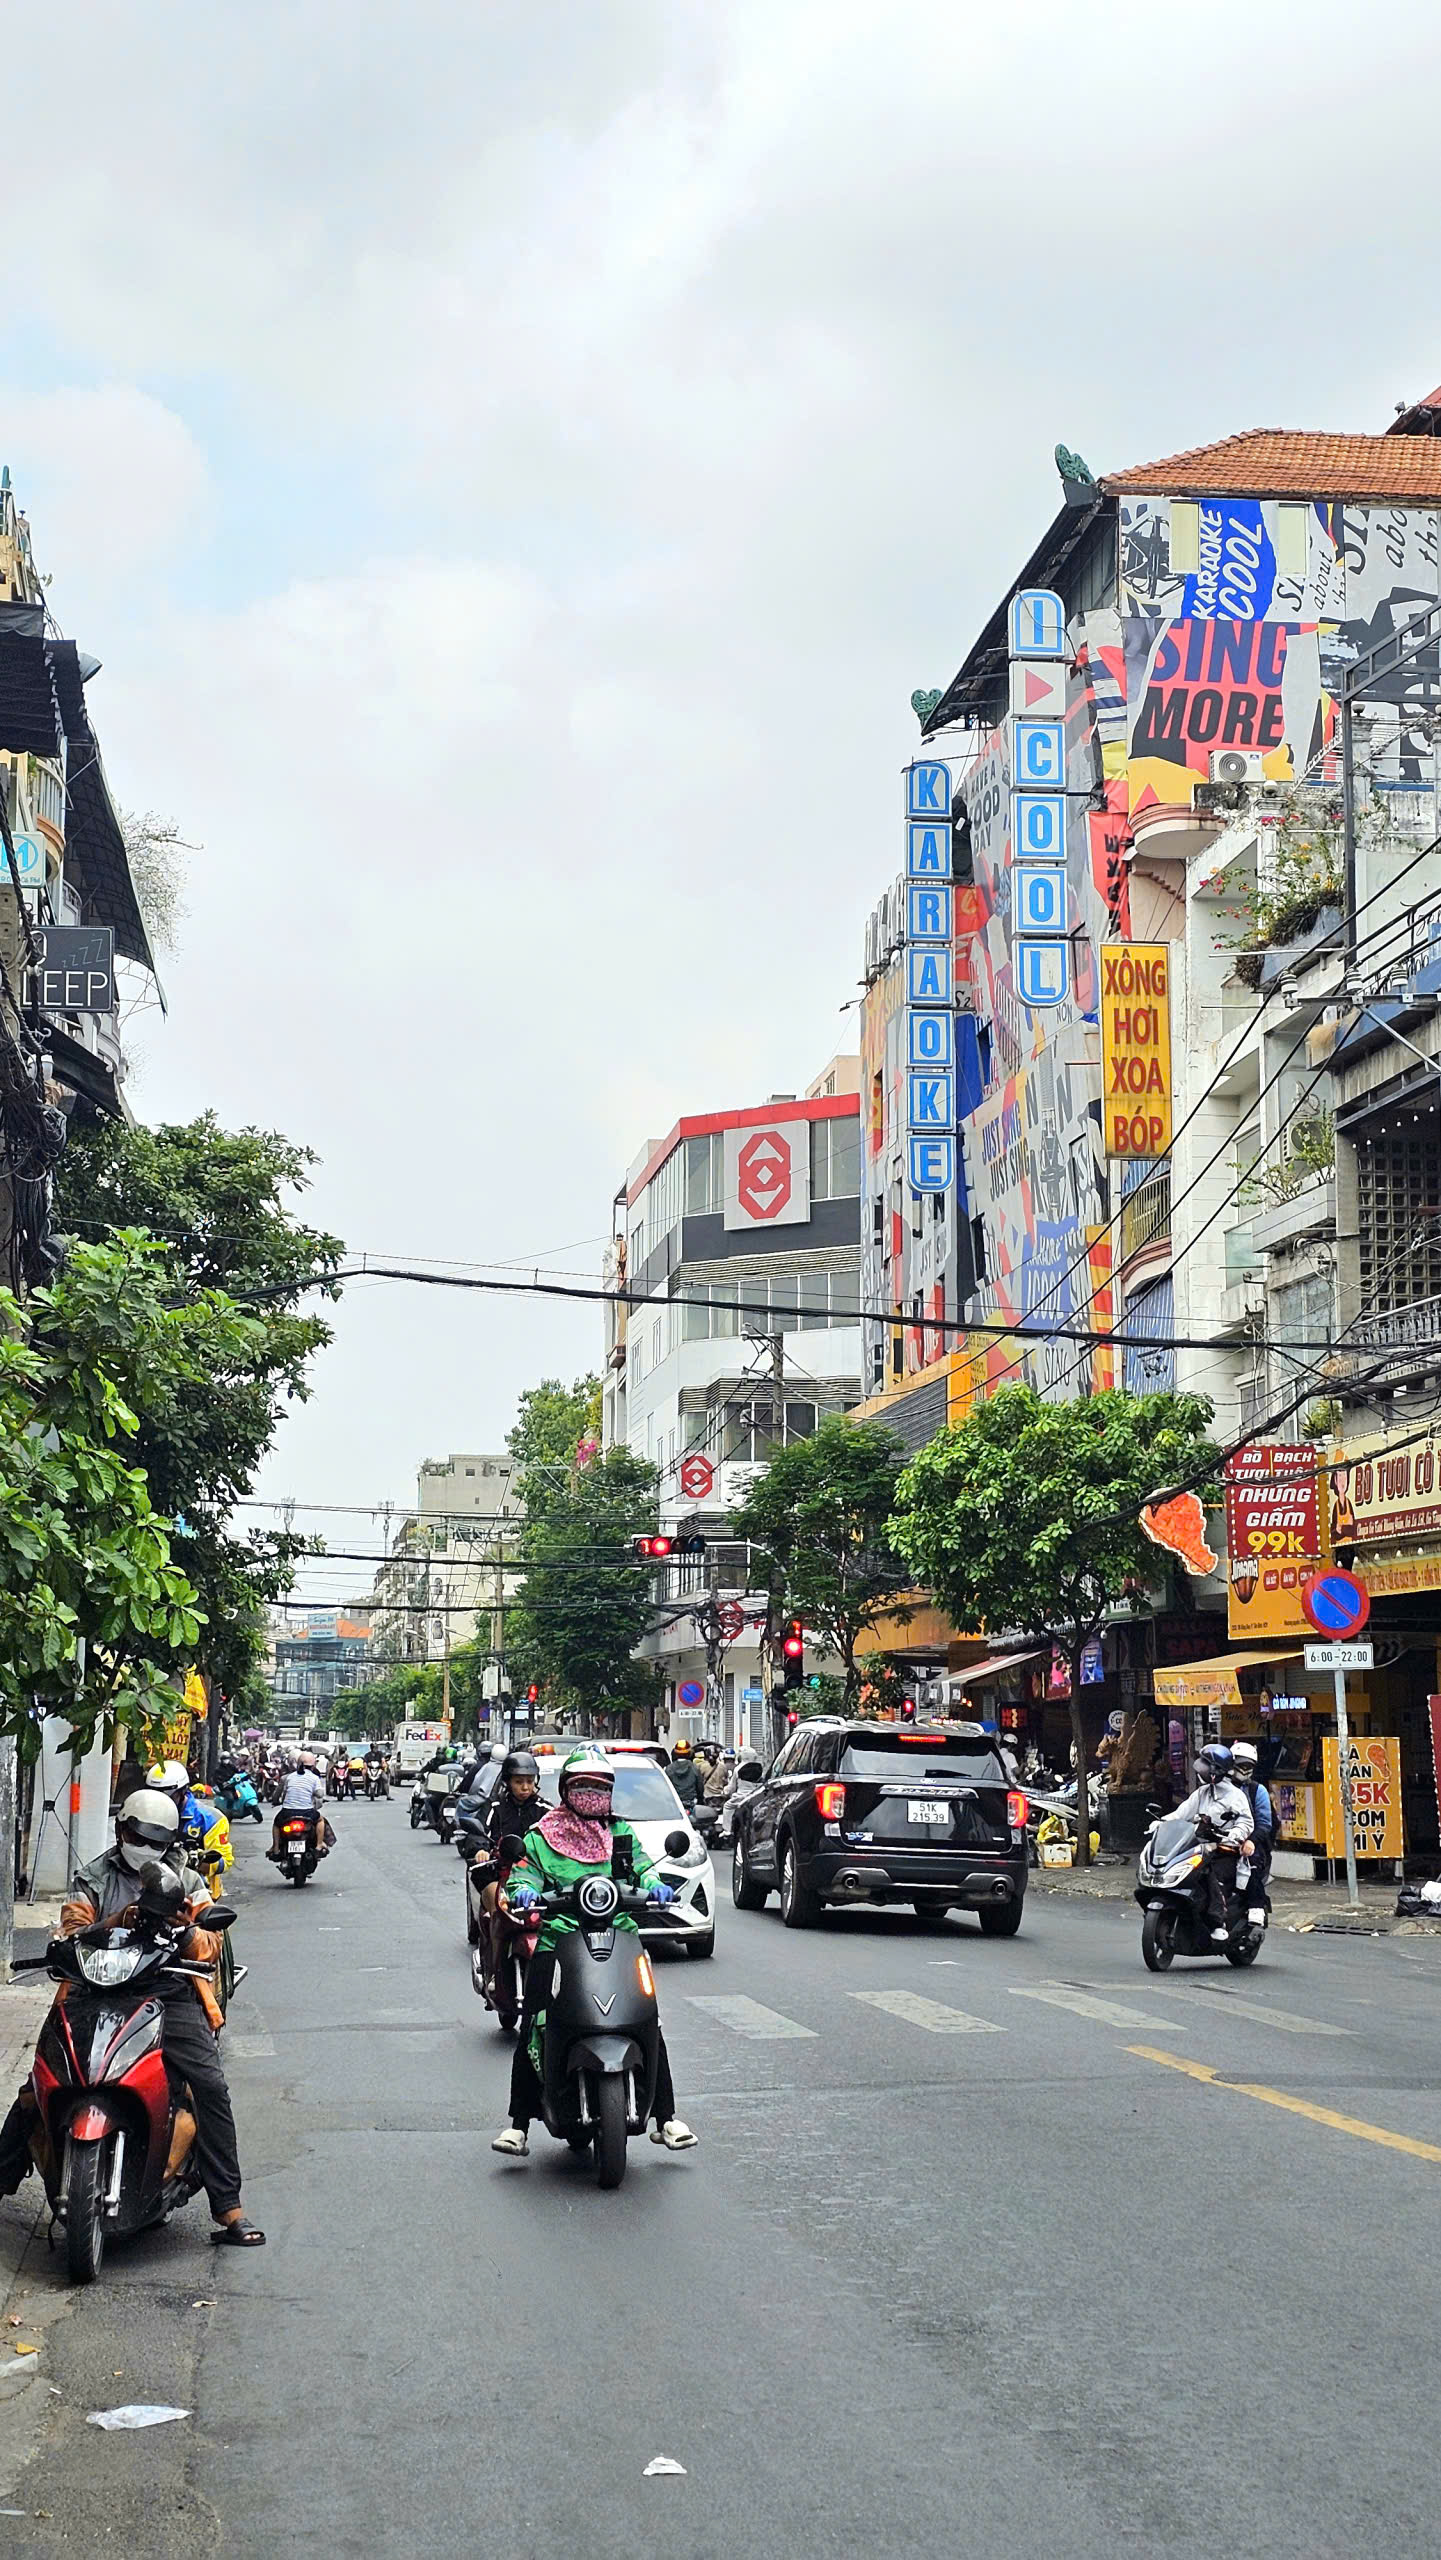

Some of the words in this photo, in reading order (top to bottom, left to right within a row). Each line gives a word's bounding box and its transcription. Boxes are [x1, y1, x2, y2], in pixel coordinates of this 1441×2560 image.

[1191, 508, 1224, 619] KARAOKE
[1218, 517, 1263, 620] COOL
[1151, 619, 1289, 688] SING
[1146, 688, 1284, 747] MORE
[970, 784, 1000, 832] OOD
[22, 970, 108, 1007] LEEP
[917, 768, 943, 1184] KARAOKE
[1104, 948, 1167, 997] XÔNG
[1114, 1004, 1159, 1046] HƠI
[1110, 1057, 1164, 1094] XOA
[982, 1116, 1001, 1166] JUST
[1002, 1099, 1023, 1151] SING
[1114, 1106, 1163, 1154] BÓP
[990, 1155, 1009, 1202] JUST
[1009, 1137, 1031, 1187] SING
[1242, 1449, 1262, 1464] BÒ
[1273, 1452, 1313, 1465] BẠCH
[1239, 1484, 1312, 1503] NHÚNG
[1246, 1505, 1307, 1527] GIẤM
[406, 1728, 442, 1741] FedEx
[919, 1802, 937, 1813] 51K
[1341, 1783, 1391, 1805] 25K
[912, 1813, 945, 1823] 215.39
